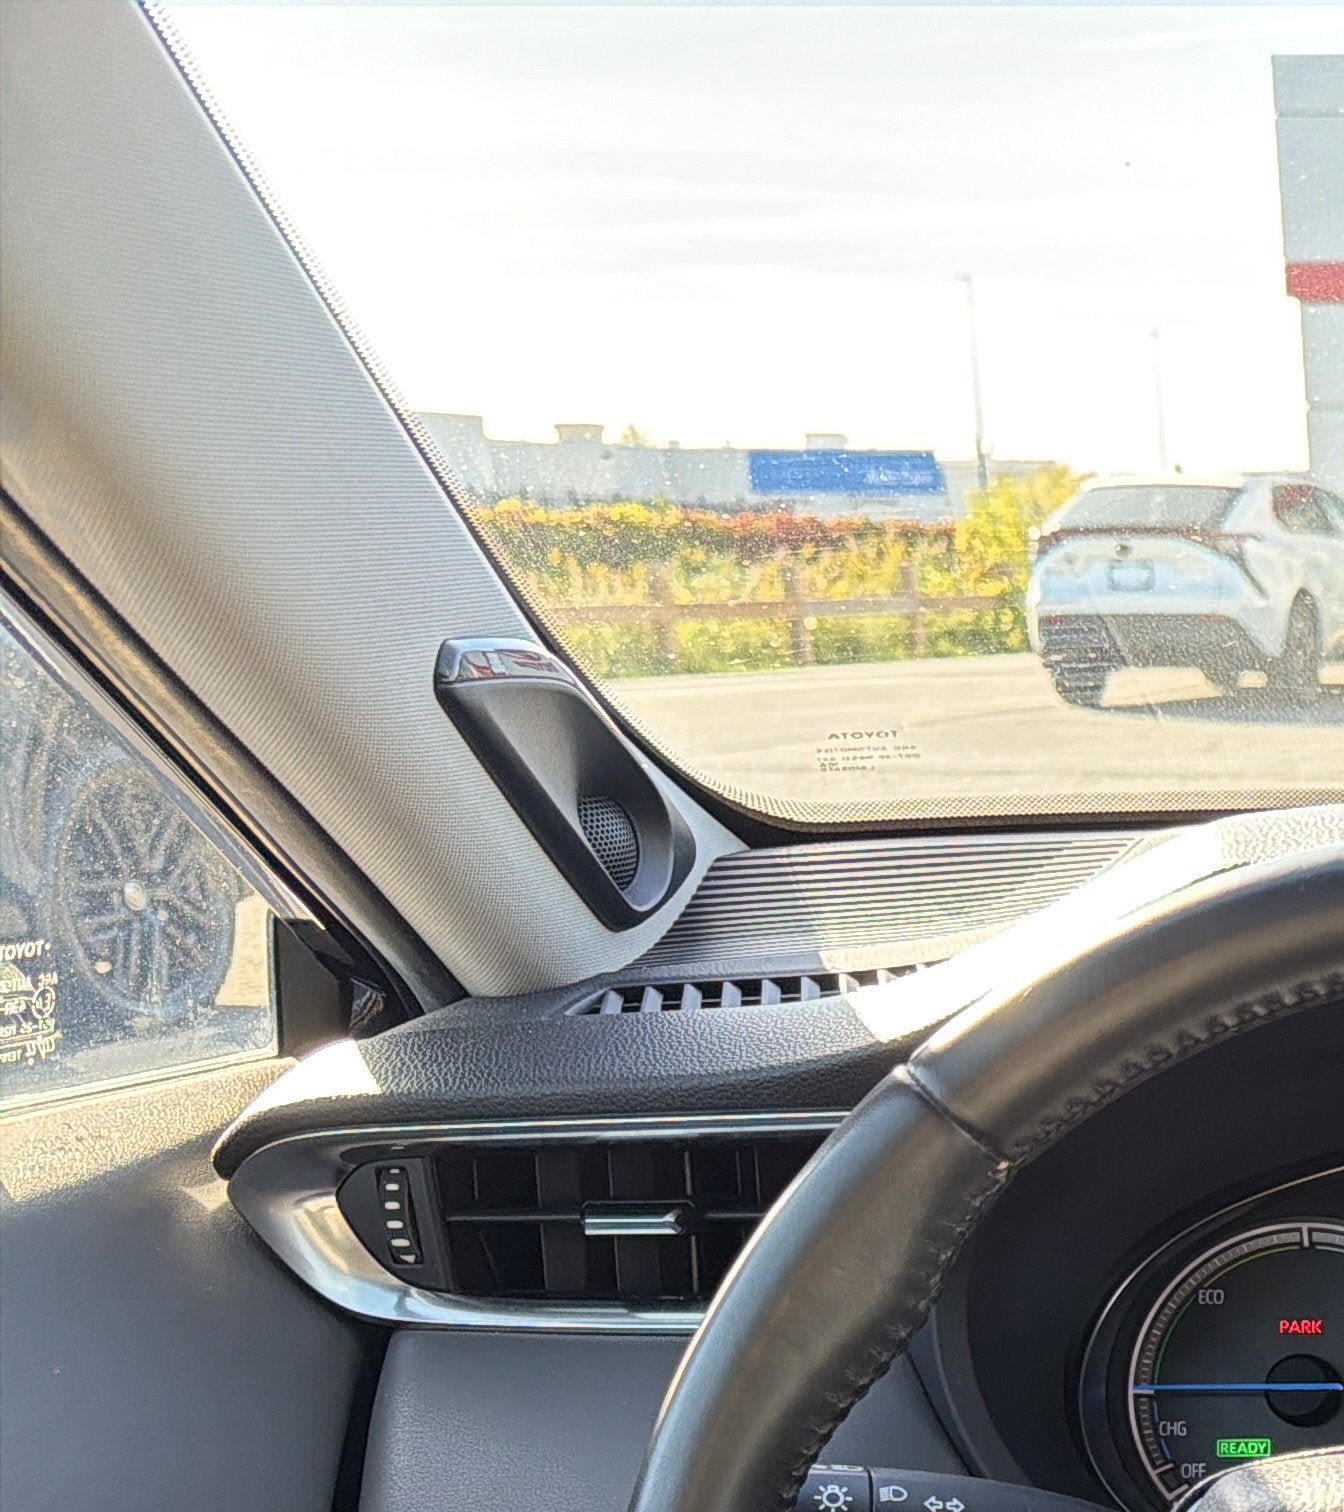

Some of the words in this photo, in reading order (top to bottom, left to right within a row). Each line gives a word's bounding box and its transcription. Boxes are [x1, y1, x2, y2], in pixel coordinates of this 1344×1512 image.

[1198, 1289, 1225, 1305] ECO
[1279, 1319, 1323, 1335] PARK
[1159, 1421, 1187, 1437] CHG
[1220, 1442, 1267, 1455] READY
[1181, 1463, 1206, 1479] OFF
